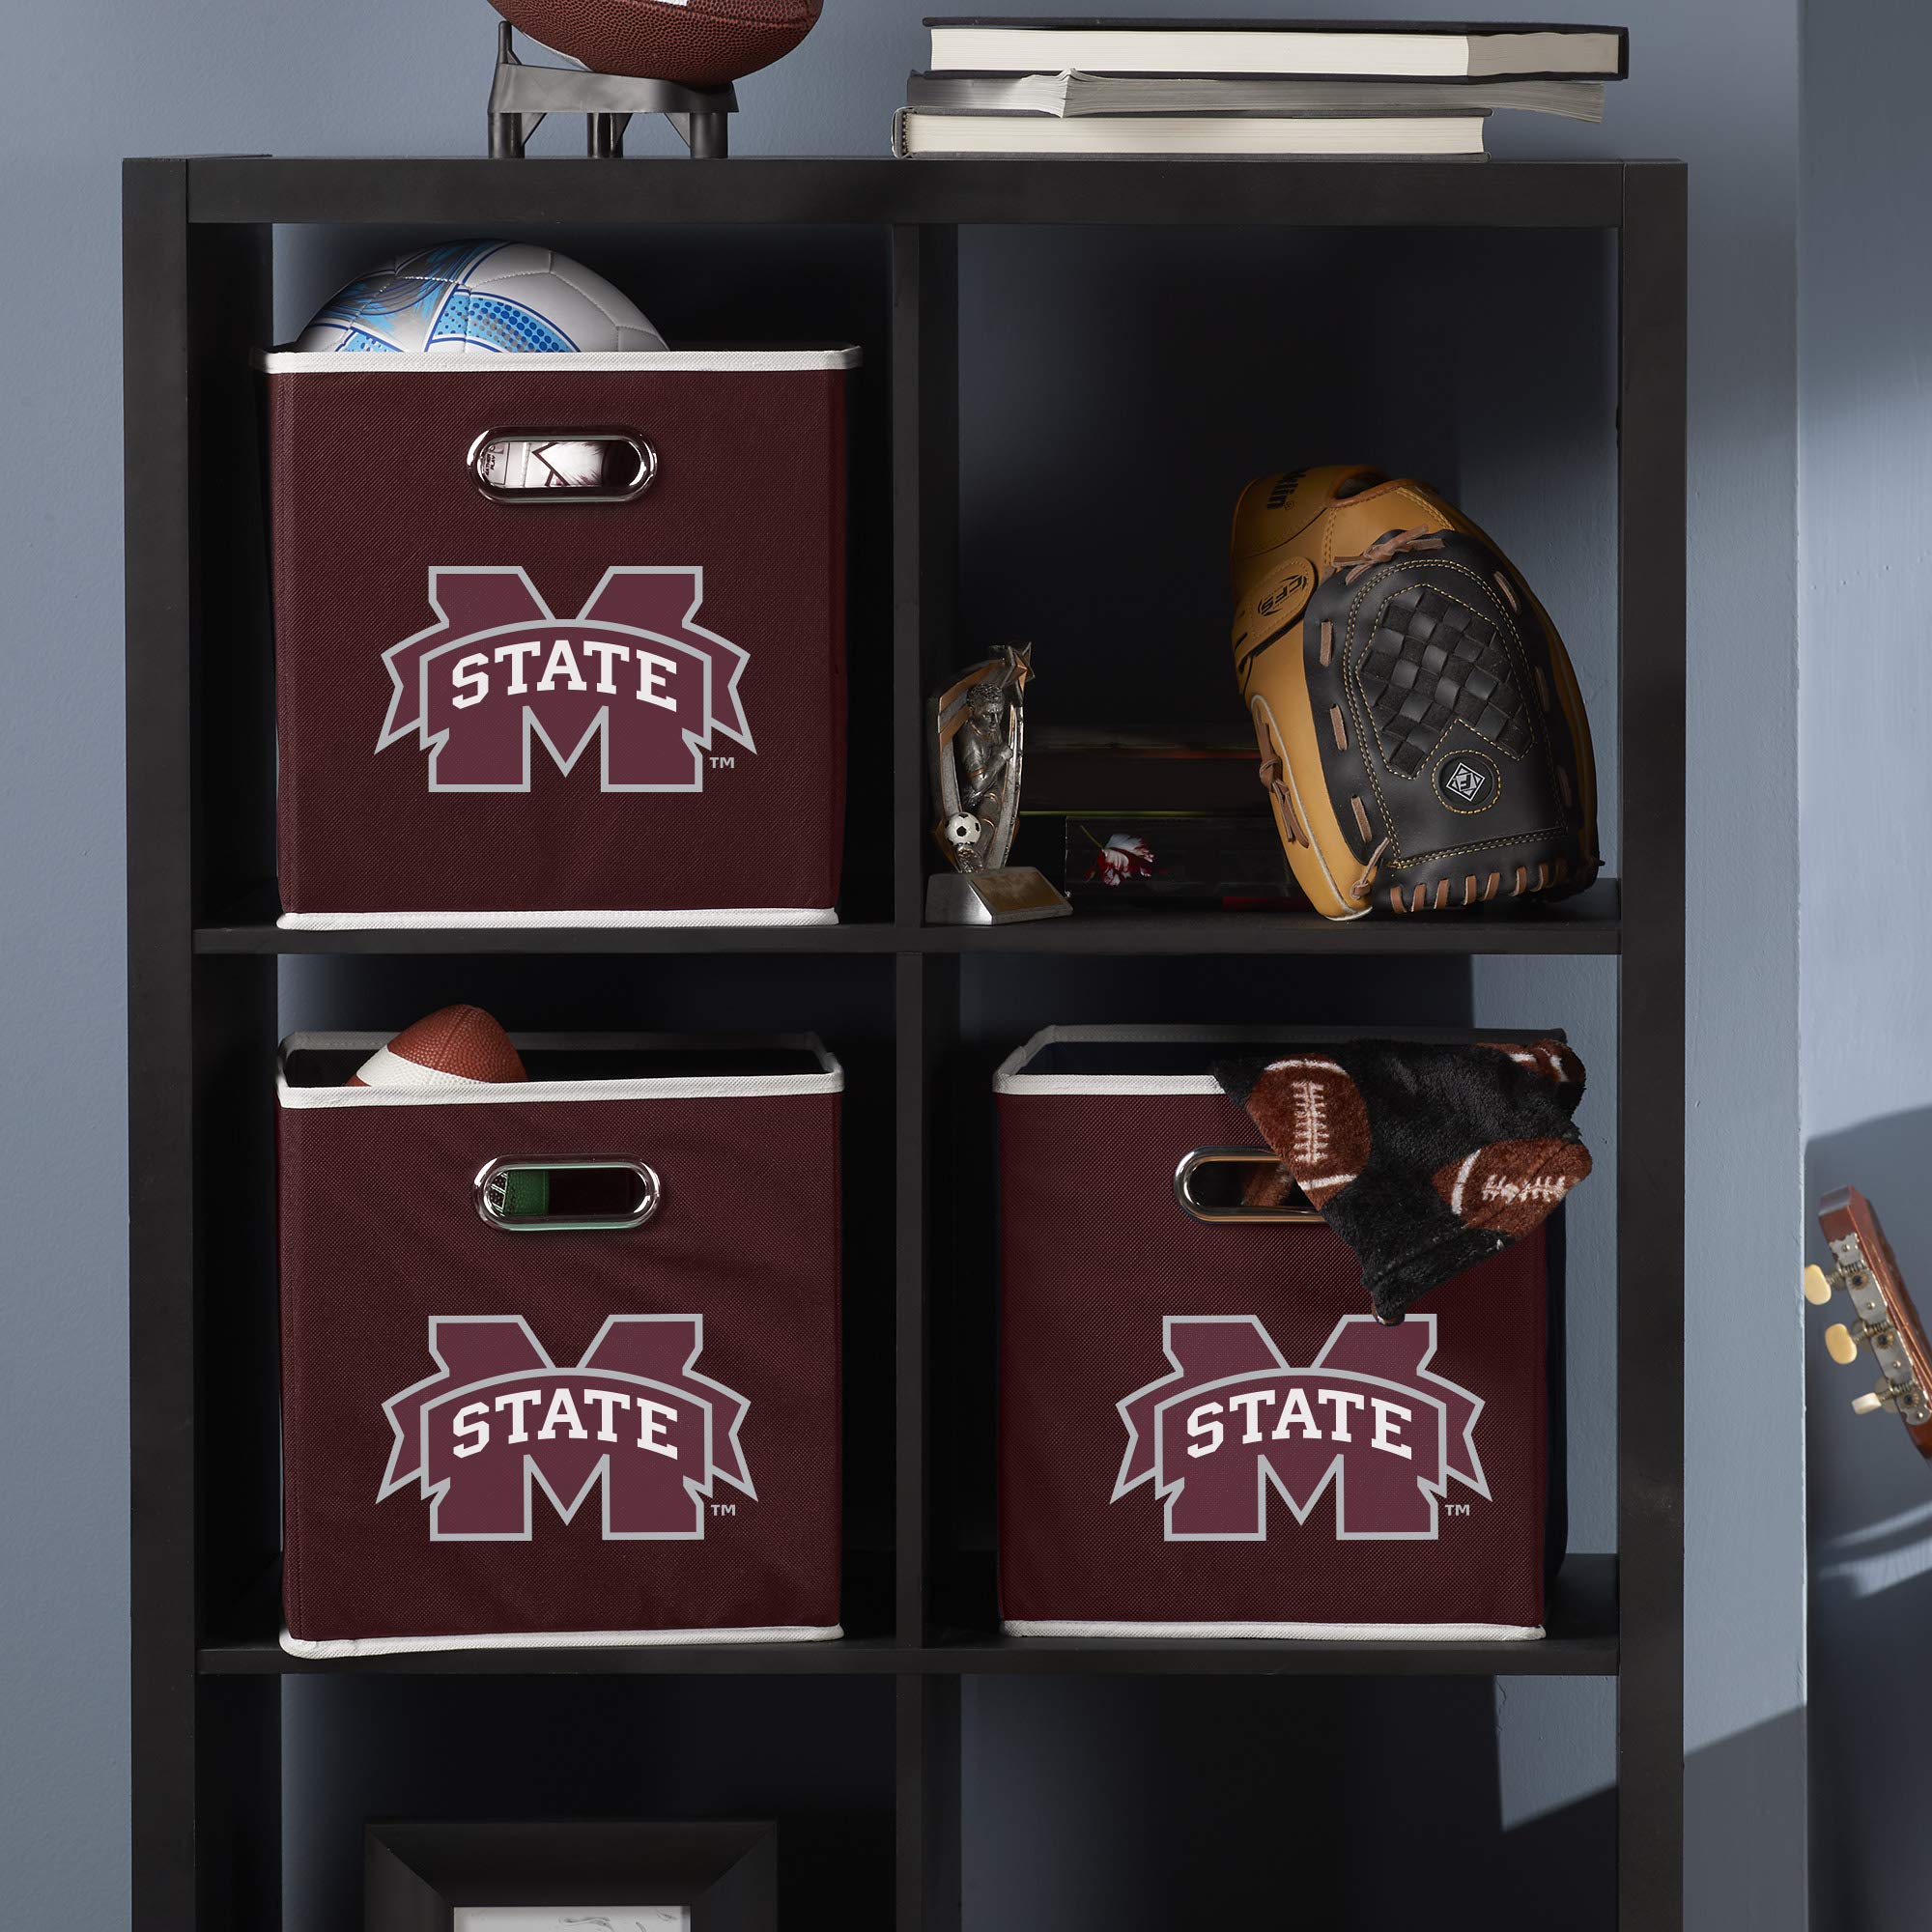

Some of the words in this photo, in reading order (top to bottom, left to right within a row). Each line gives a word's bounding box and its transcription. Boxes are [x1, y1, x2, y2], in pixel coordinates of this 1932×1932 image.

[452, 639, 677, 713] STATE
[709, 756, 735, 769] TM
[452, 1387, 678, 1461] STATE
[1186, 1387, 1412, 1461] STATE
[710, 1504, 736, 1517] TM
[1444, 1504, 1470, 1517] TM
